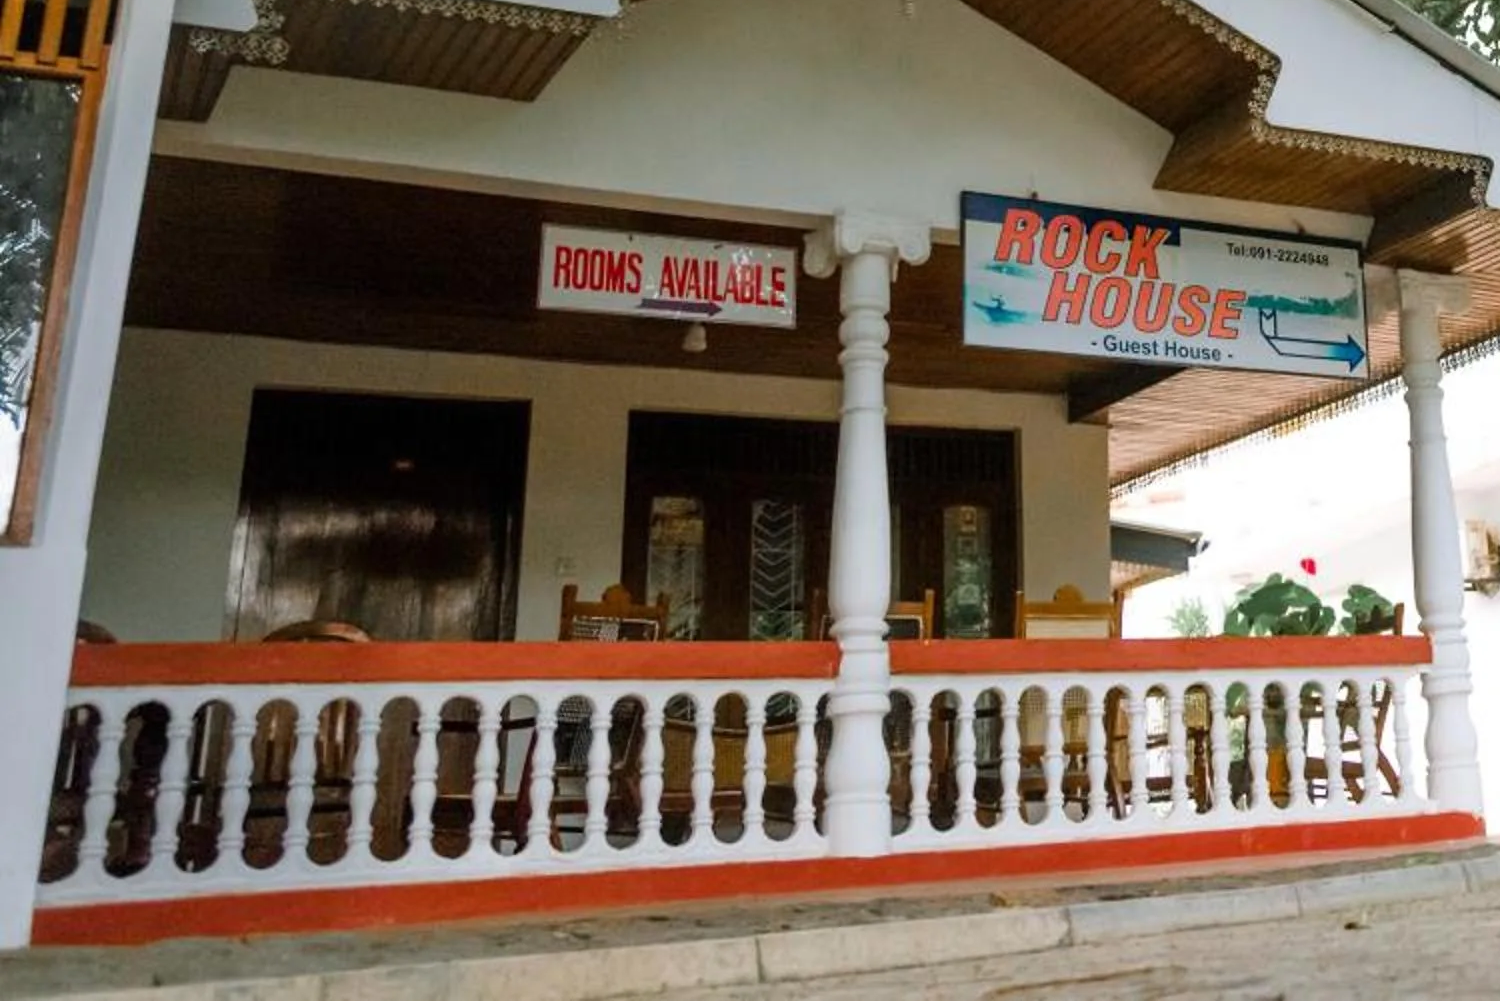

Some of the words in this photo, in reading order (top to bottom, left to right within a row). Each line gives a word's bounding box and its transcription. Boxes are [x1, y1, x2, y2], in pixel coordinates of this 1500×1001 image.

[994, 207, 1169, 279] ROCK
[553, 245, 643, 294] ROOMS
[659, 255, 786, 308] AVAILABLE
[1042, 270, 1246, 339] HOUSE
[1103, 335, 1158, 356] Guest
[1165, 340, 1221, 361] House
